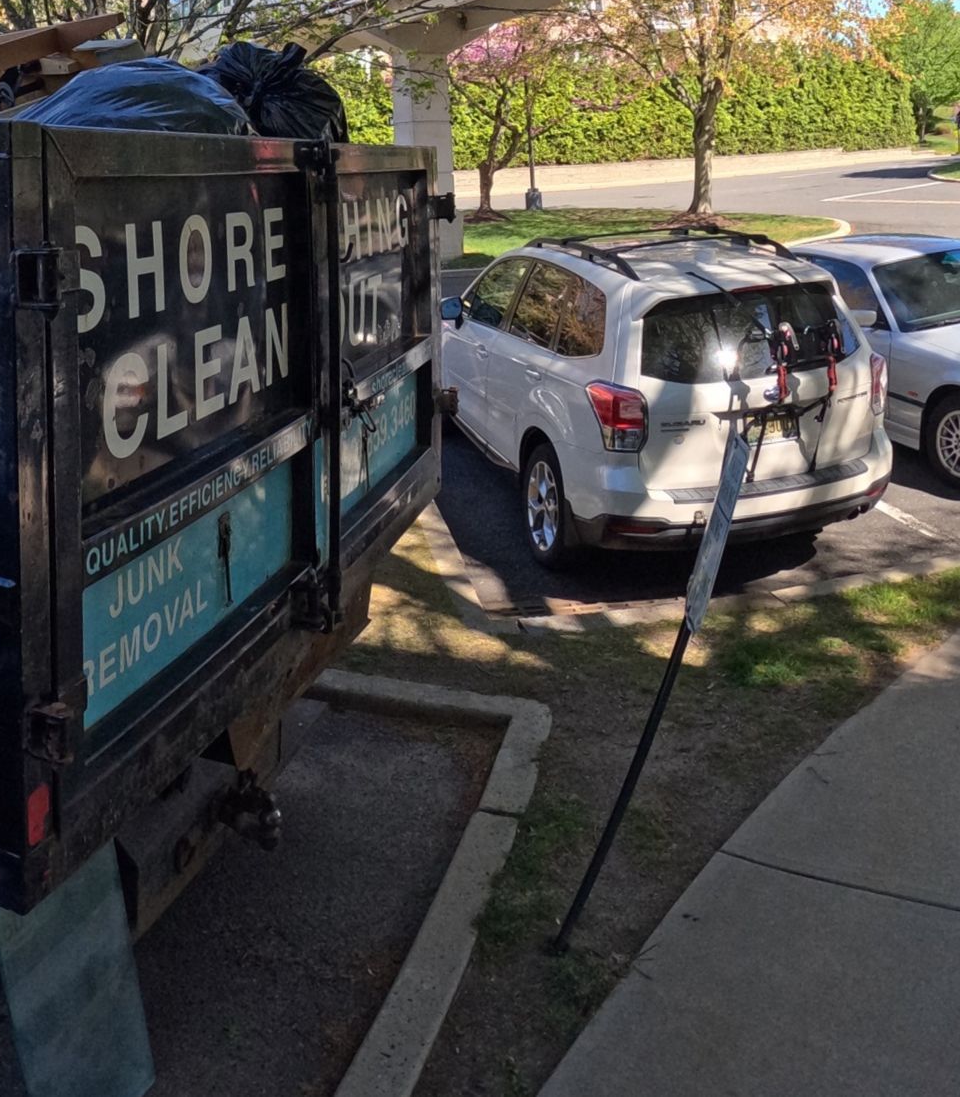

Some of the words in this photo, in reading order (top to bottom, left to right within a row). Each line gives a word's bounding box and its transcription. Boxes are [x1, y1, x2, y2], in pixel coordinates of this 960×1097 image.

[74, 207, 287, 334] SHORE
[342, 194, 409, 263] HING
[103, 303, 290, 460] CLEAN
[340, 274, 382, 346] UT
[109, 536, 183, 619] JUNK
